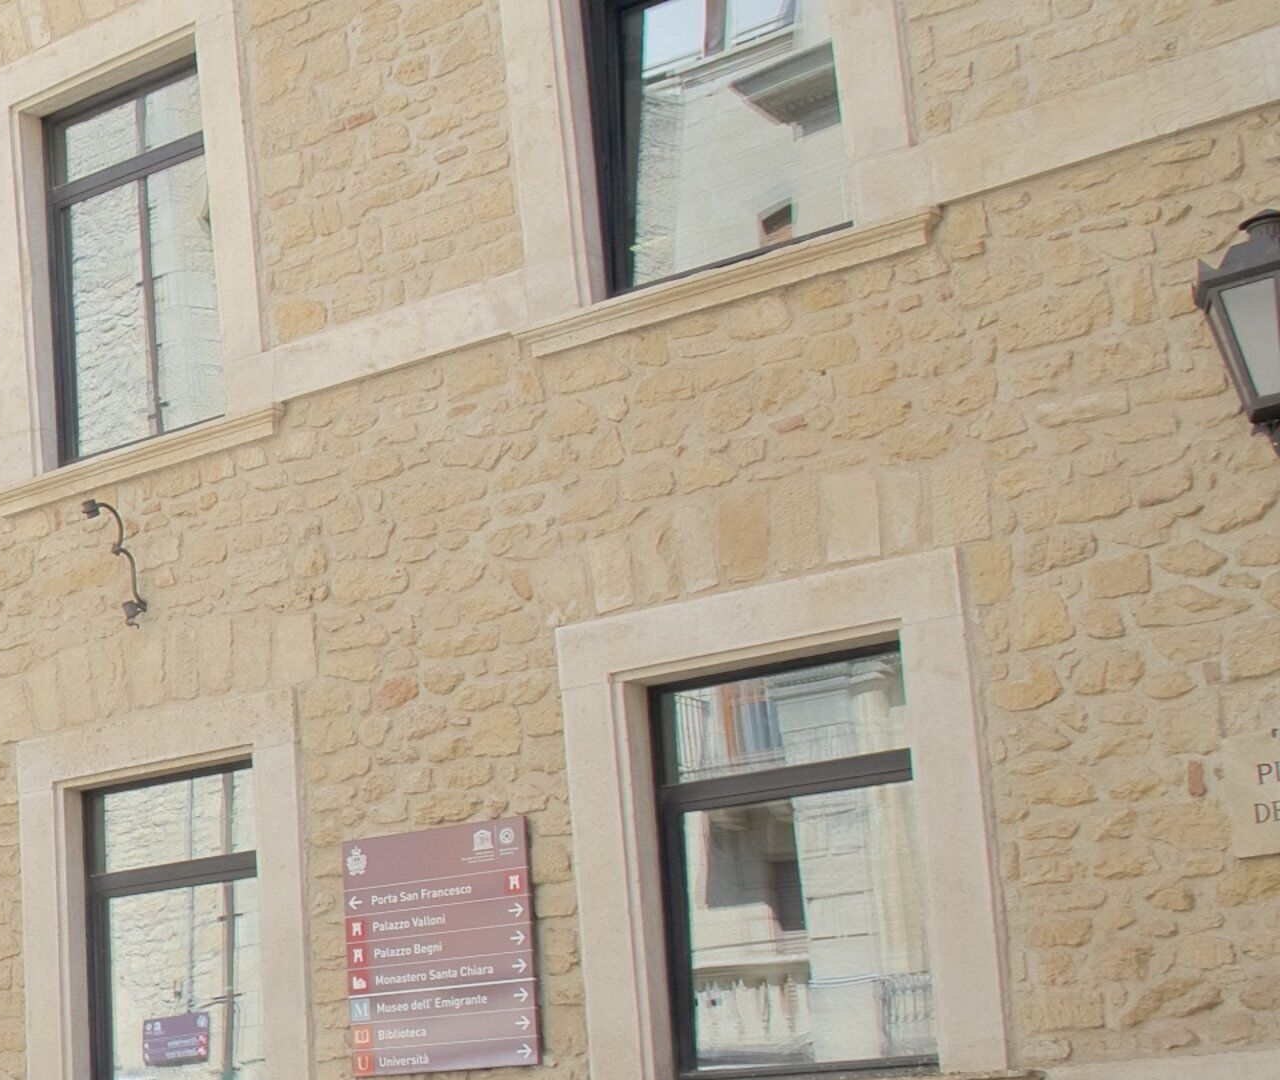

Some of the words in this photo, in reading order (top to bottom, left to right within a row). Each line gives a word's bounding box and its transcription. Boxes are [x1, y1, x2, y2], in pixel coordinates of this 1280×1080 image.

[371, 893, 398, 906] Porta
[400, 891, 419, 902] San
[421, 885, 472, 899] Francesco
[372, 919, 410, 933] Palazzo
[411, 914, 446, 928] Valloni
[374, 946, 411, 959] Palazzo
[413, 941, 442, 956] Begni
[375, 972, 427, 986] Monastero
[429, 968, 458, 980] Santa
[460, 966, 494, 977] Chiara
[376, 1002, 408, 1014] Museo
[411, 998, 433, 1010] dell'
[435, 995, 488, 1009] Emigrante
[378, 1029, 427, 1041] Biblioteca
[379, 1053, 429, 1068] Università
